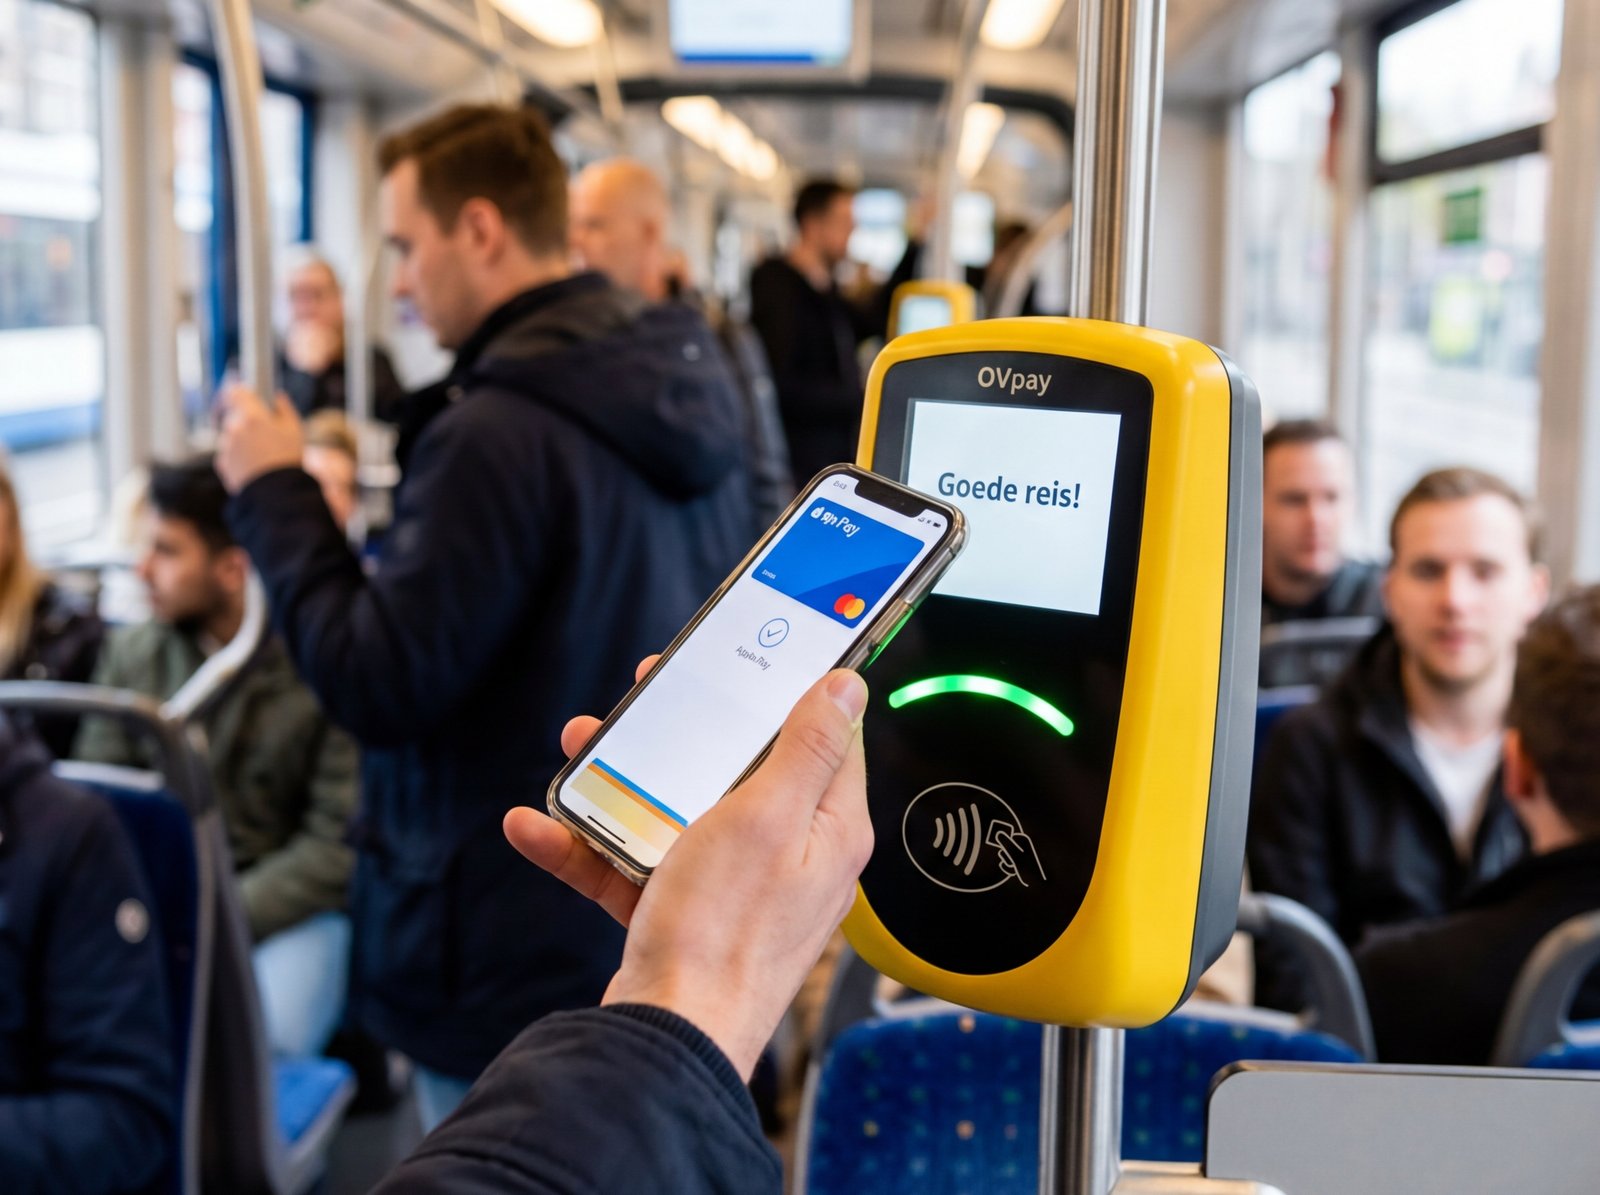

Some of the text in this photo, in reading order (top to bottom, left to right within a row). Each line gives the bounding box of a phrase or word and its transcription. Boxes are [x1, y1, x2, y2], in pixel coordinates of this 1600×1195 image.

[977, 366, 1052, 397] OVpay
[937, 472, 1081, 509] Goede reis!
[835, 516, 861, 538] Pay
